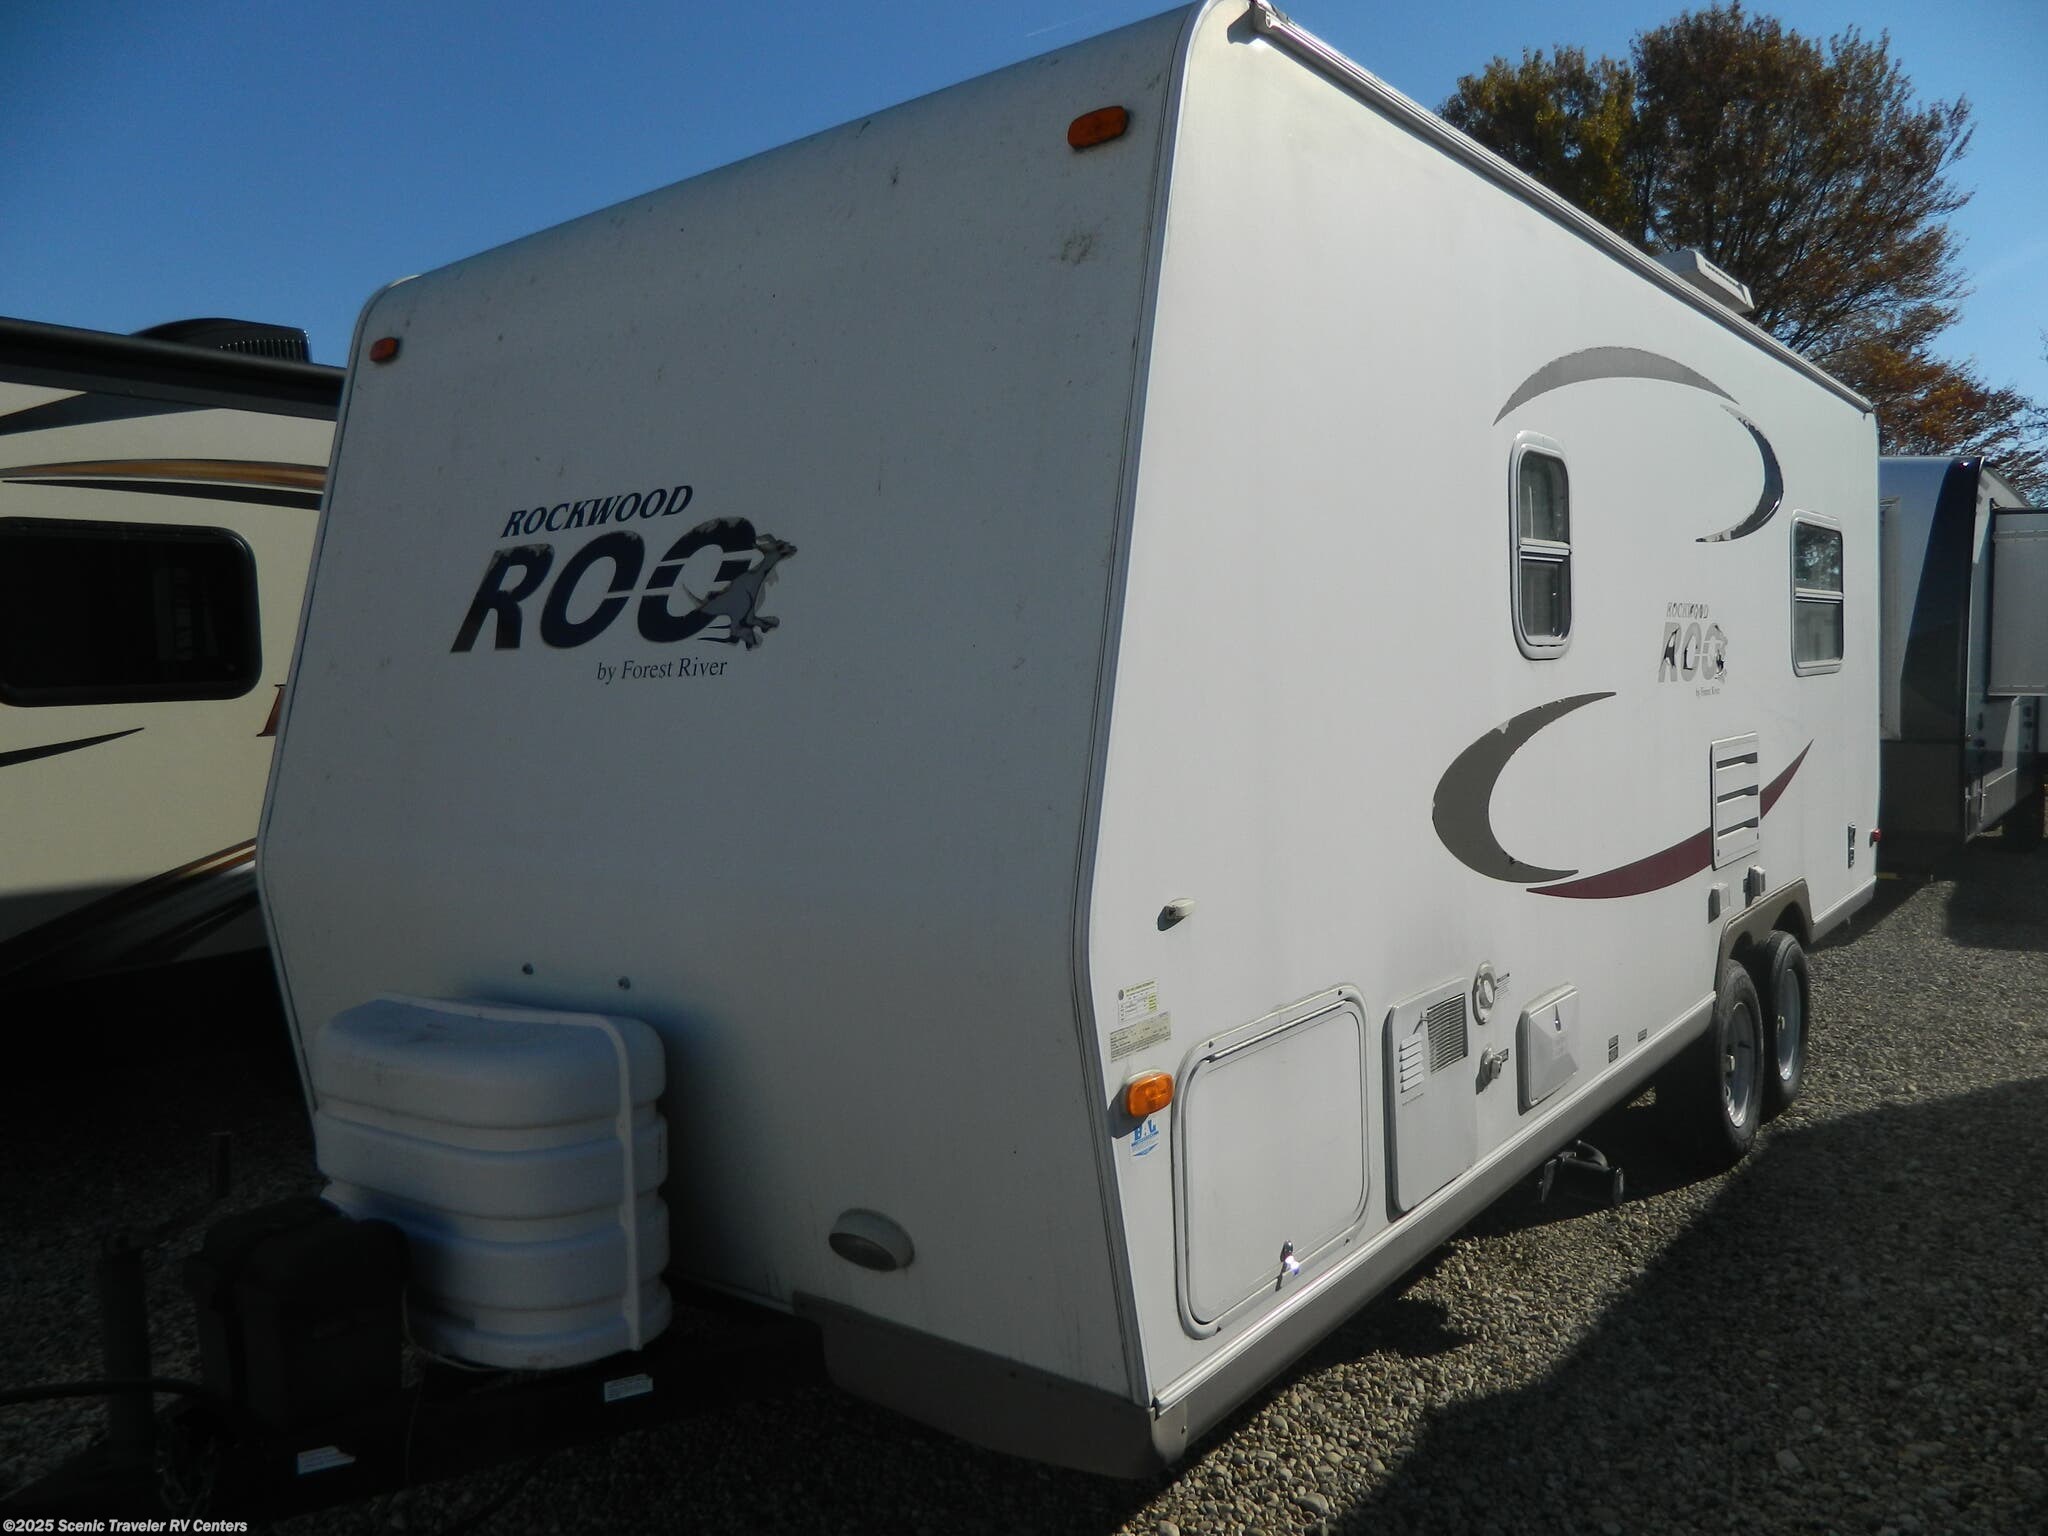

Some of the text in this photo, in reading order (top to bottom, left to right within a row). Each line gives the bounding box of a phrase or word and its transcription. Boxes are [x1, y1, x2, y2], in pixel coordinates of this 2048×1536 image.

[501, 485, 693, 539] ROCKWOOD
[449, 516, 760, 654] ROO
[596, 656, 728, 685] by Forest River
